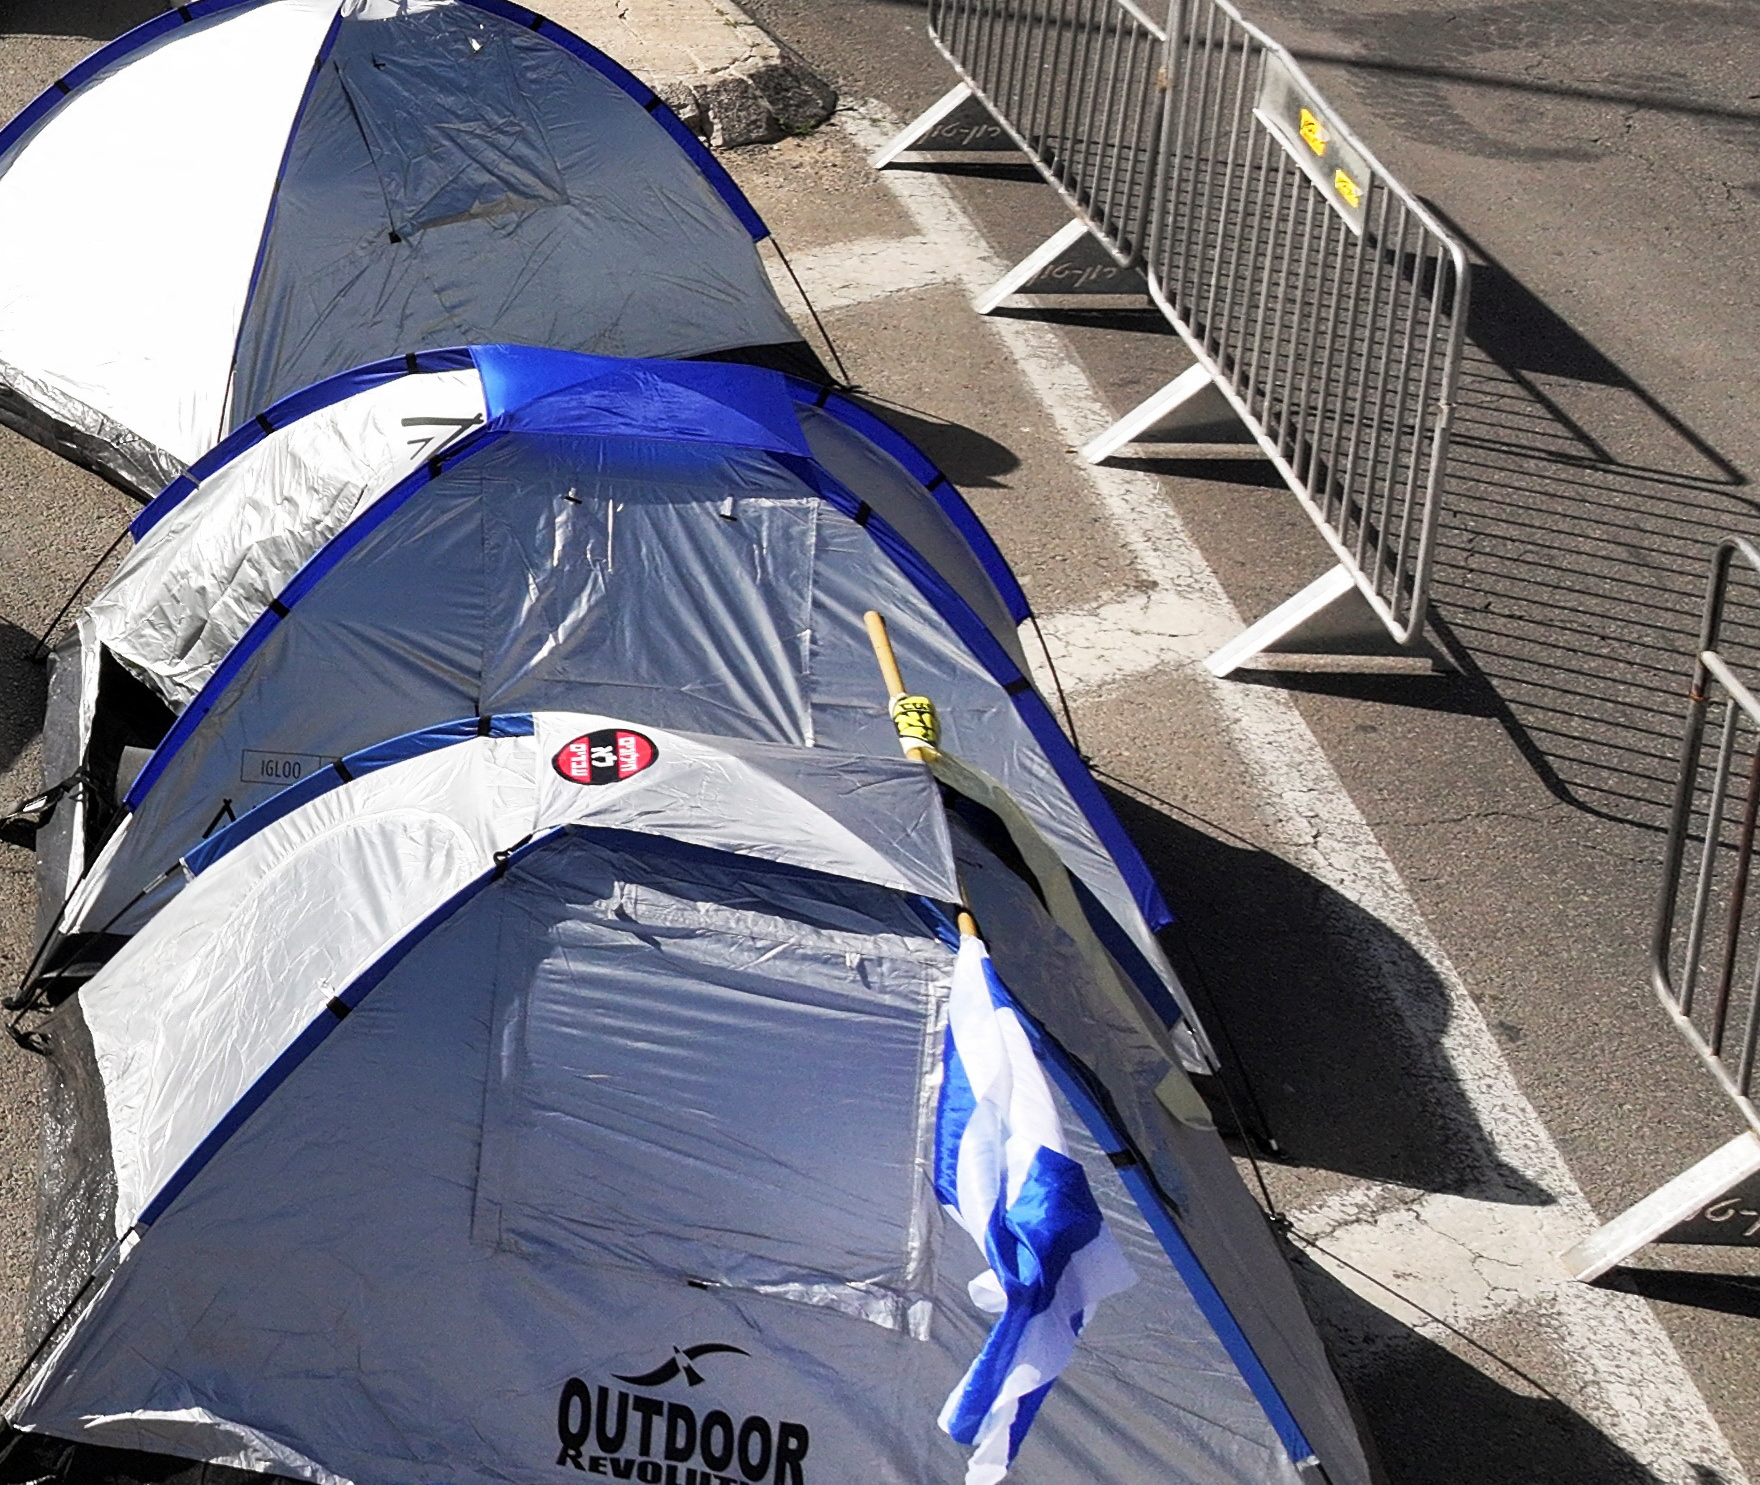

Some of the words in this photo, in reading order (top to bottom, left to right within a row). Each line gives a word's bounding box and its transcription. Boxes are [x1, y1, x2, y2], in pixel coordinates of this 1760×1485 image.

[260, 758, 301, 780] IGLOO
[590, 744, 618, 770] לא
[618, 735, 637, 773] חילונים
[557, 1377, 810, 1485] OUTDOOR
